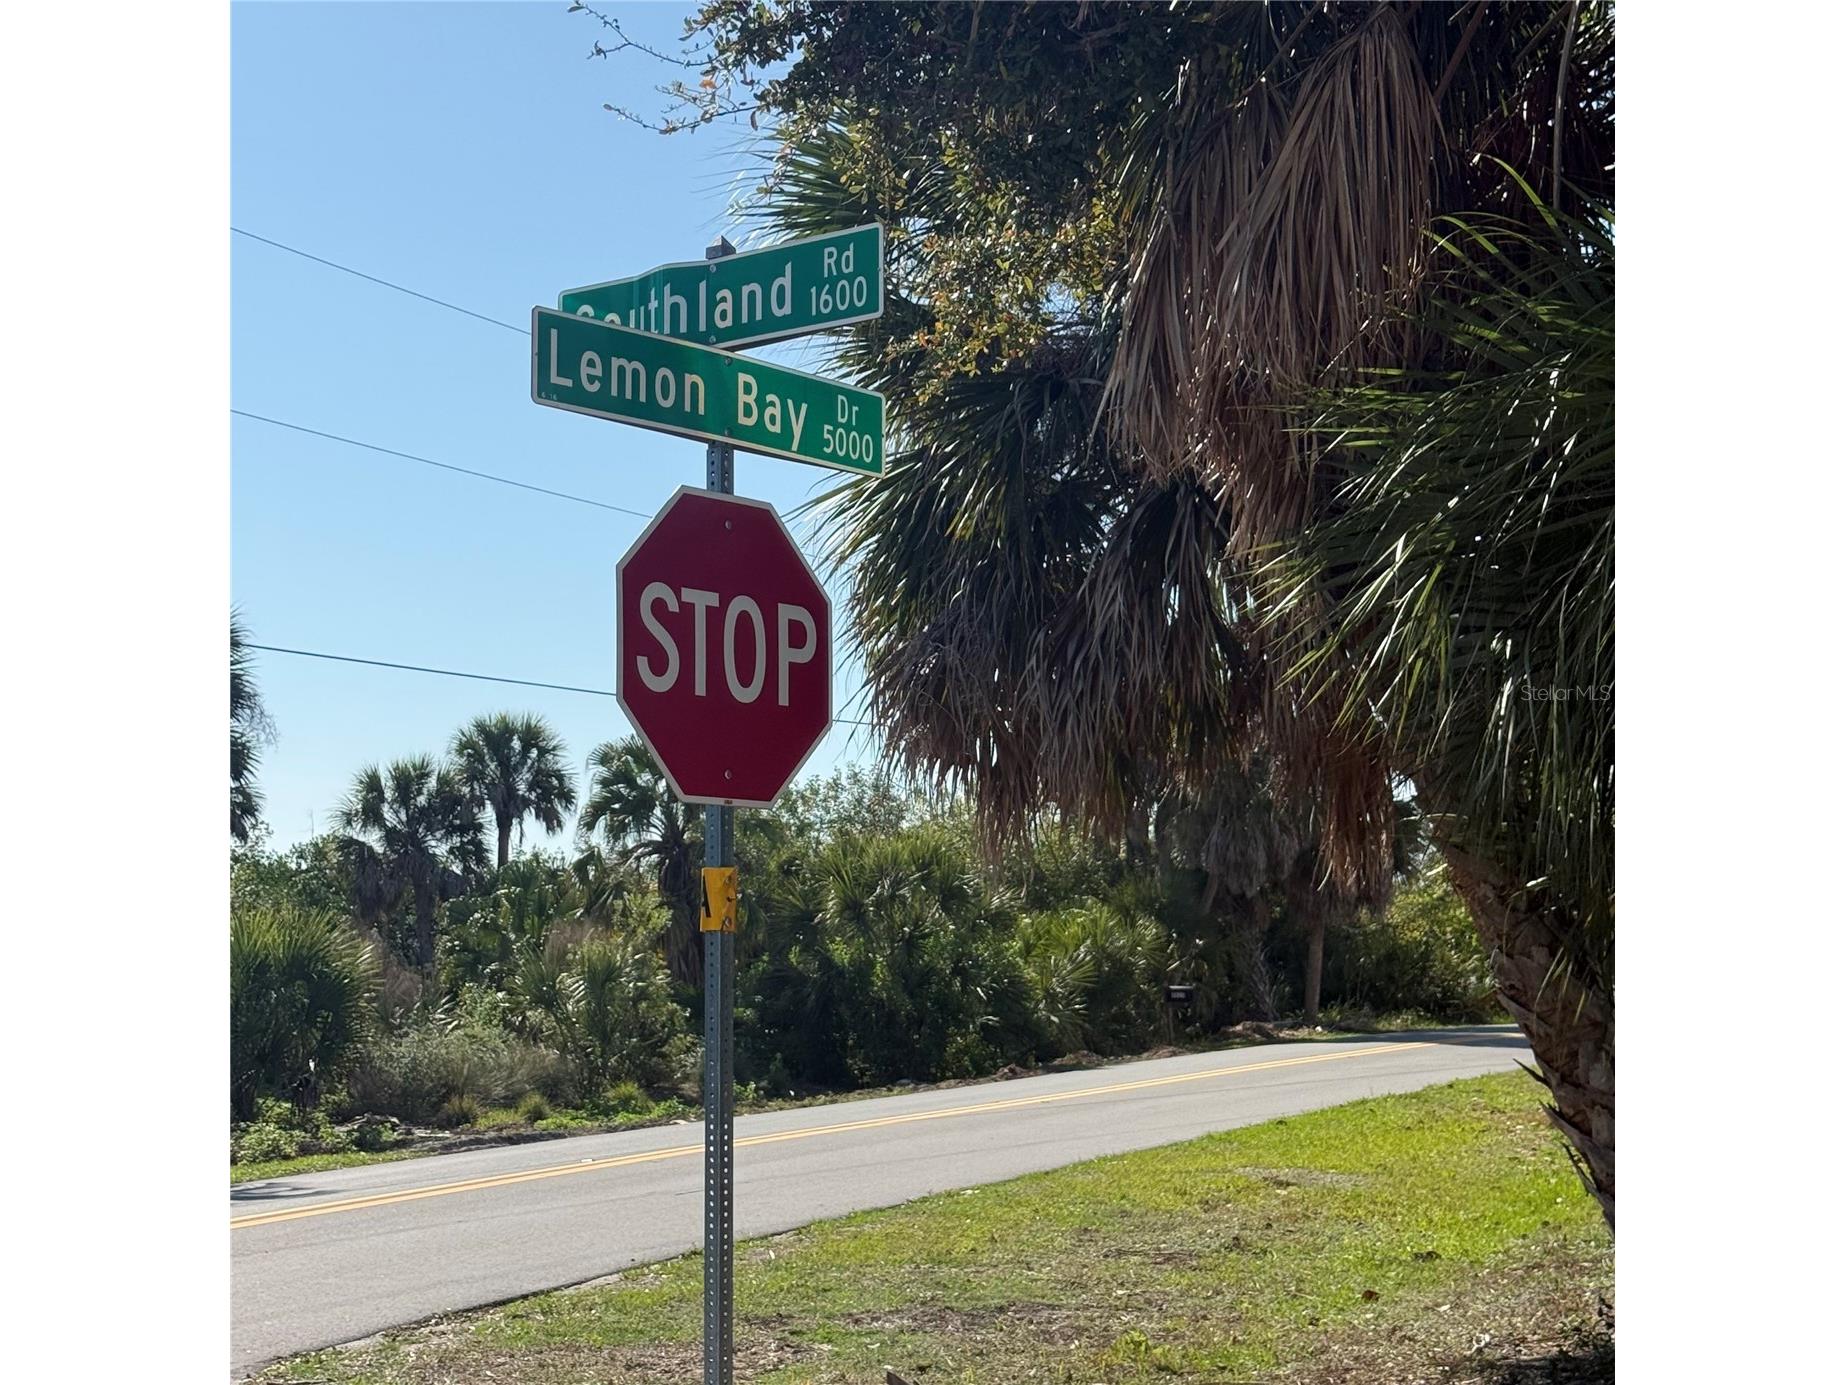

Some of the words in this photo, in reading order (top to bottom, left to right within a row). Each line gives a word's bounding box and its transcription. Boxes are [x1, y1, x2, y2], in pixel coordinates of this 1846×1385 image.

[823, 243, 854, 278] Rd
[810, 276, 867, 316] 1600
[550, 328, 705, 416] Lemon
[737, 372, 808, 451] Bay
[838, 395, 859, 426] Dr
[823, 425, 873, 463] 5000
[636, 581, 817, 706] STOP
